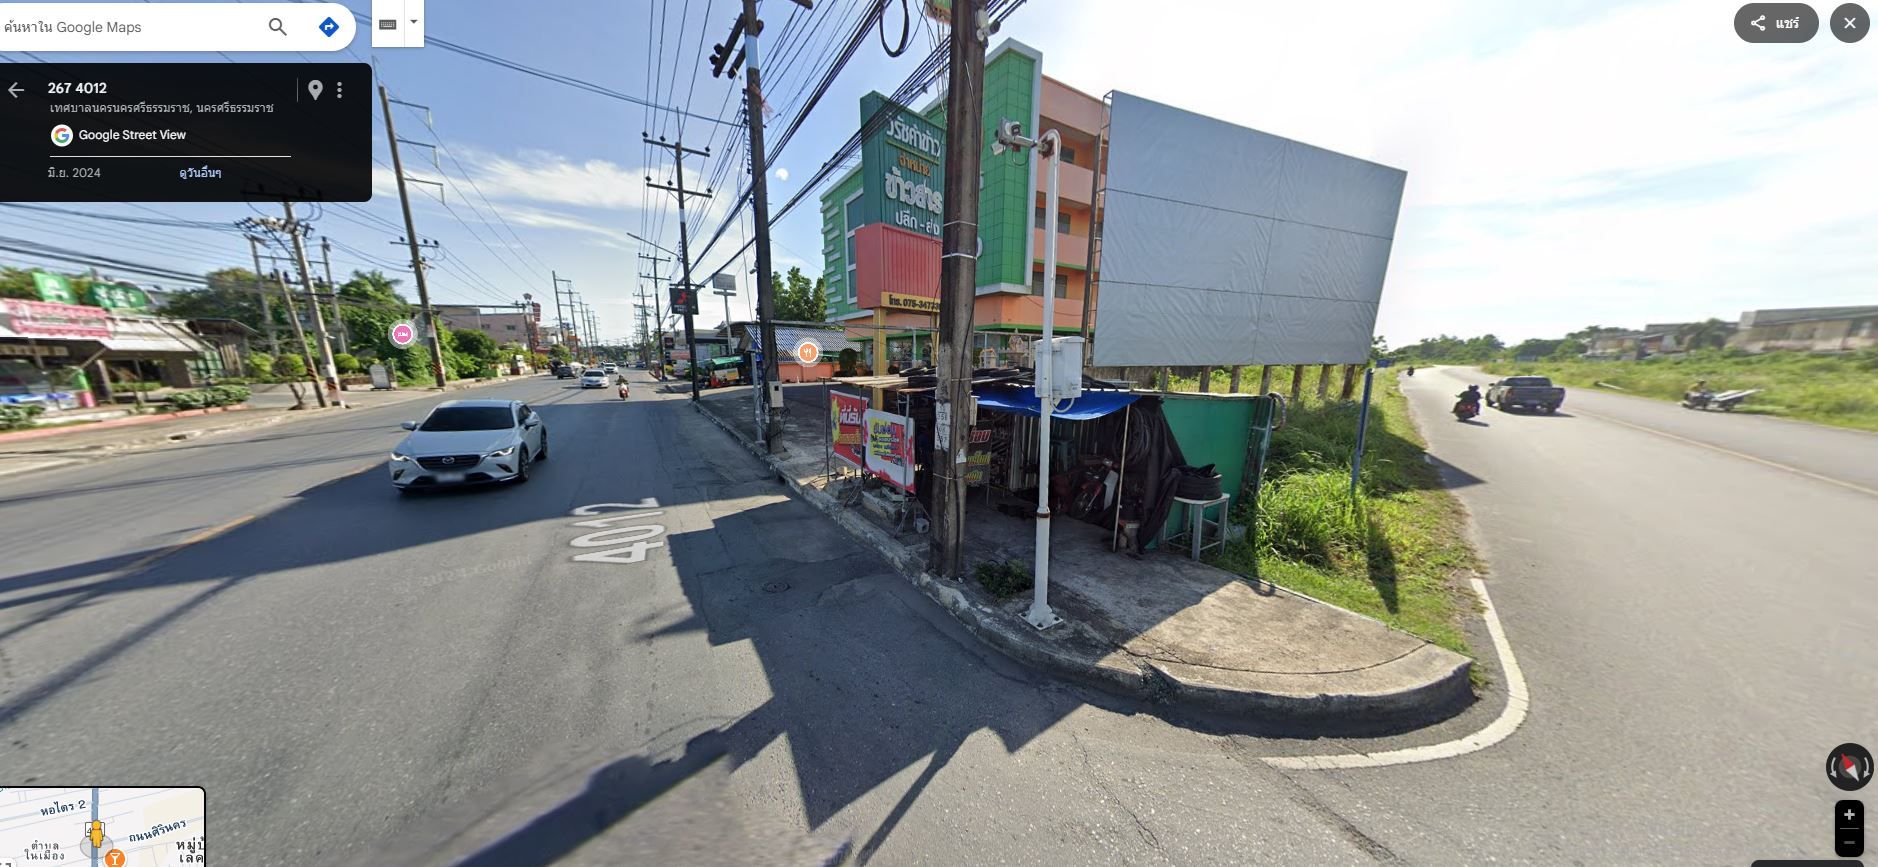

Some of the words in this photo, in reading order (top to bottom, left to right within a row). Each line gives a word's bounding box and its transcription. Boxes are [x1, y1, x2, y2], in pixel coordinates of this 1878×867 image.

[885, 166, 943, 215] ข้าวสาร
[896, 210, 917, 230] ปลีก
[926, 218, 940, 236] ส่ง
[570, 497, 665, 564] 4012
